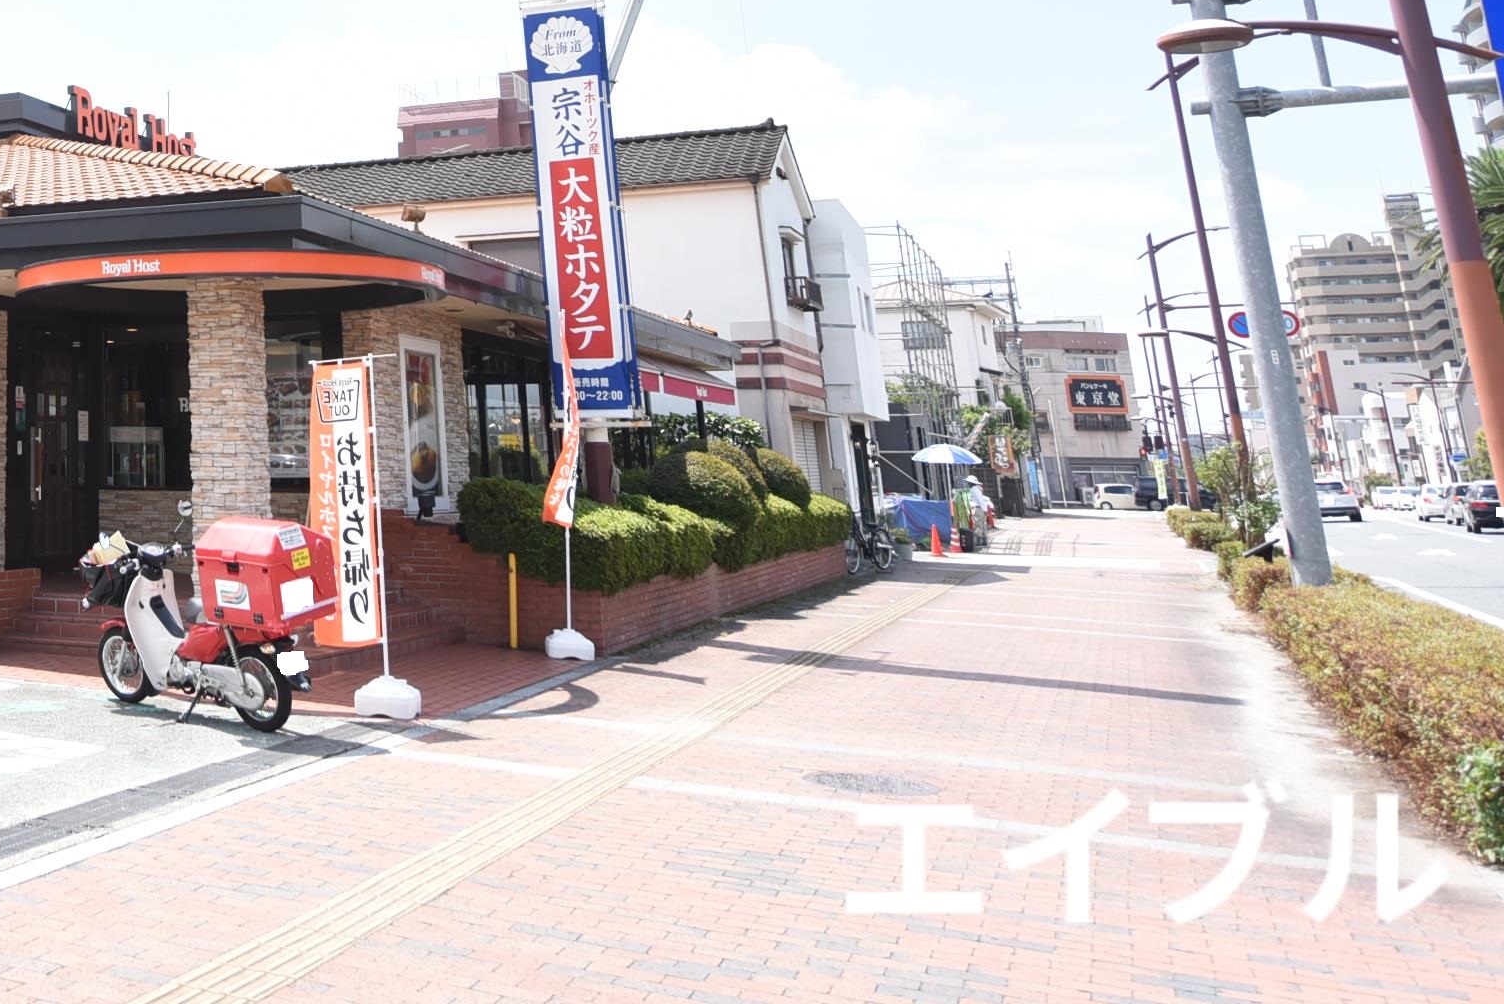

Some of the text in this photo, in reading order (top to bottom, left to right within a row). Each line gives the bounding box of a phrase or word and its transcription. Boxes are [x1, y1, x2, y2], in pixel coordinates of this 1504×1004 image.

[545, 29, 576, 40] From
[543, 40, 582, 57] 北海道
[67, 85, 140, 150] Royal
[584, 79, 600, 155] オホーツク産
[551, 88, 605, 350] 宗谷 大粒ホタテ
[101, 258, 161, 276] Royal Host
[1074, 391, 1121, 406] 東京堂
